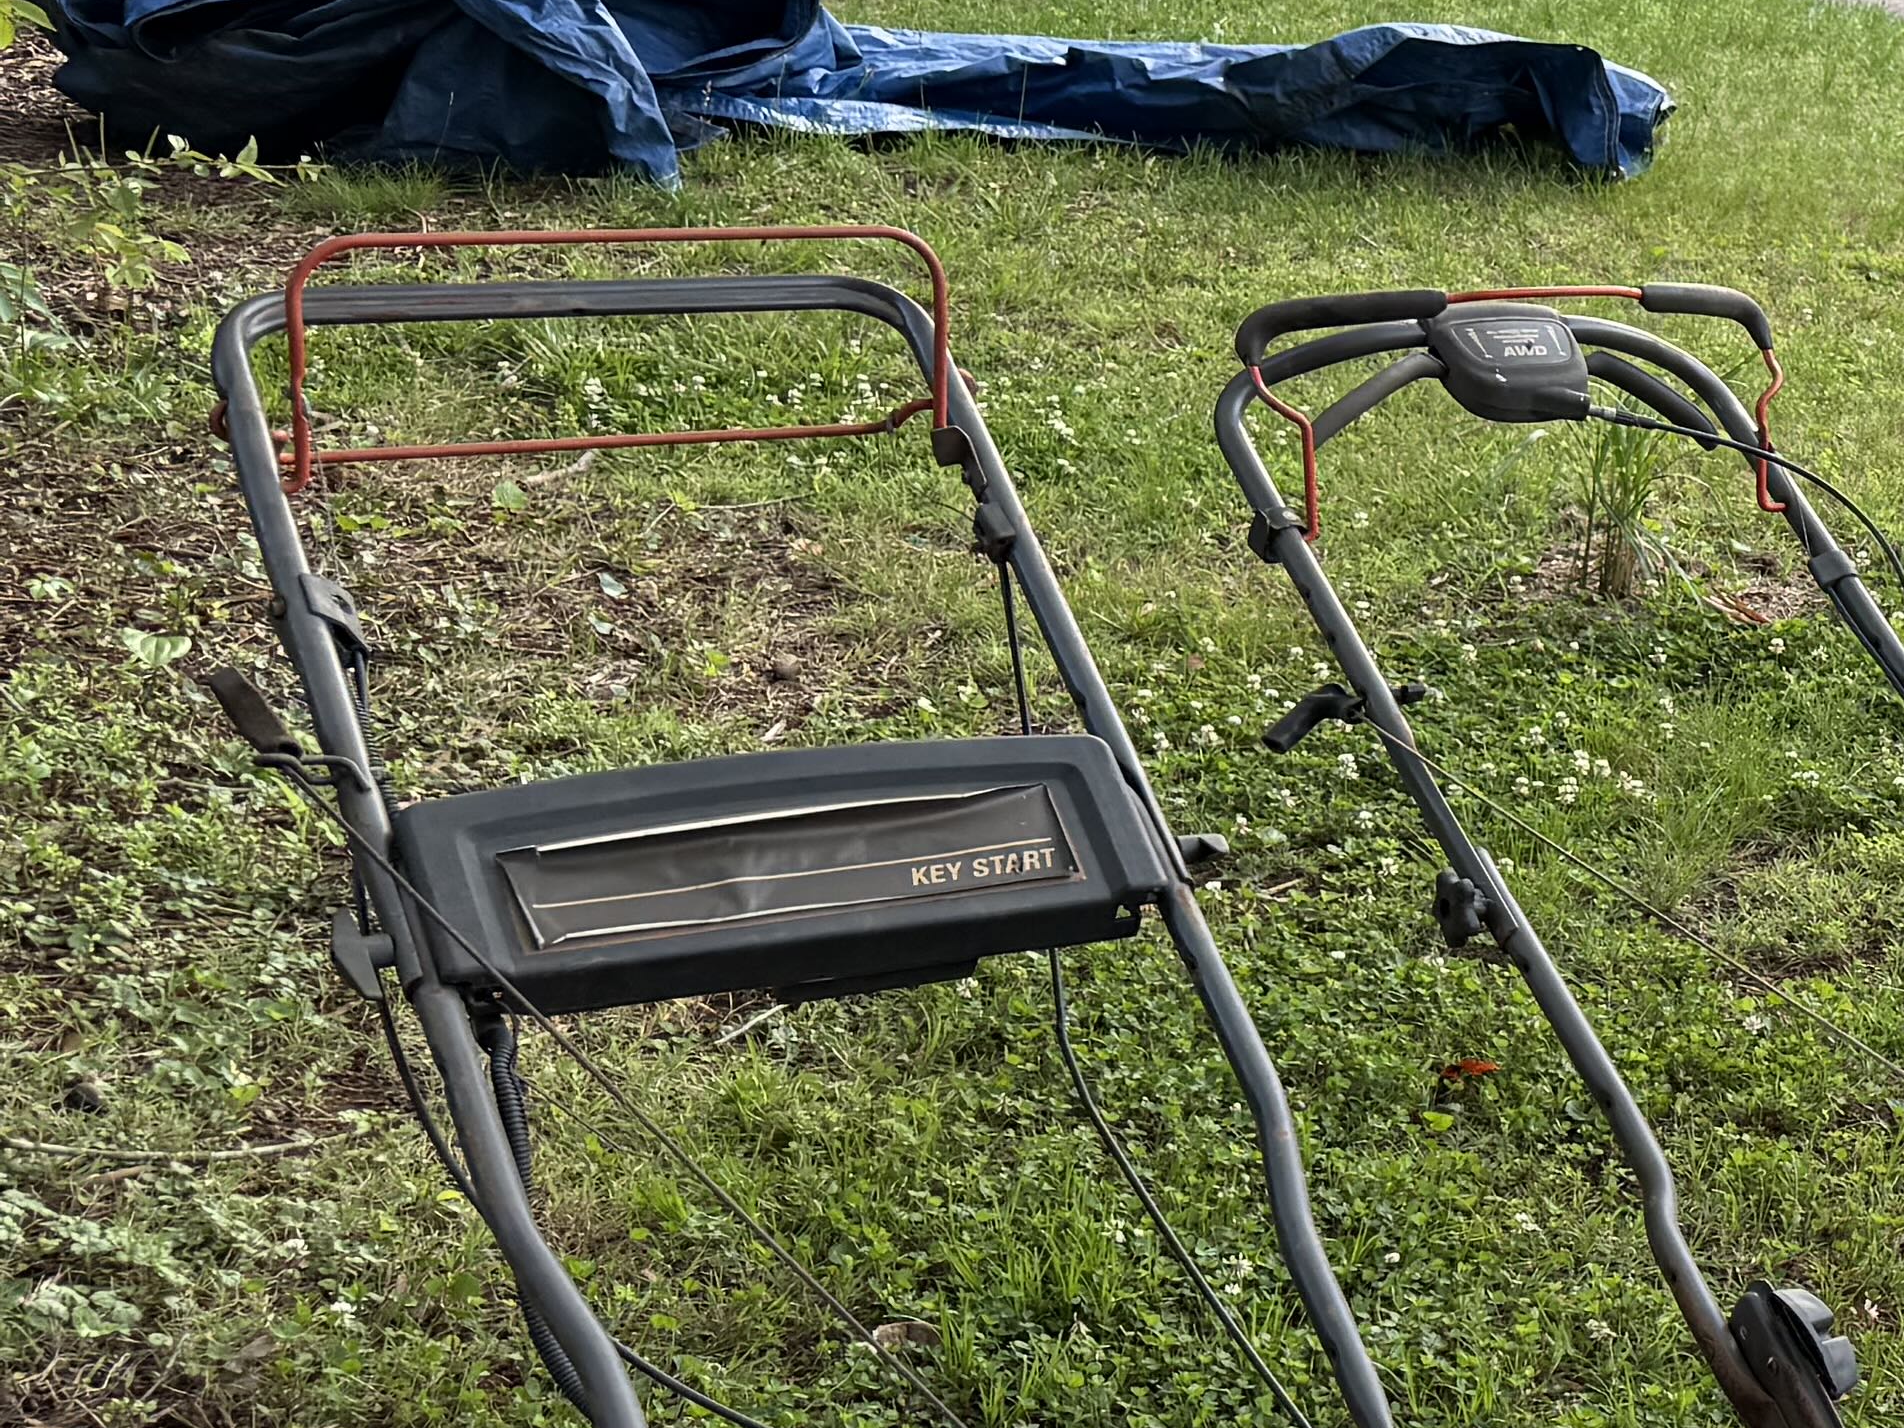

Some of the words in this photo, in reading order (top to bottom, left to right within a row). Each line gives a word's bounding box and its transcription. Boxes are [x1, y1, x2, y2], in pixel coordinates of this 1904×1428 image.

[1504, 345, 1547, 357] AWD
[911, 862, 962, 886] KEY
[973, 848, 1056, 878] START
